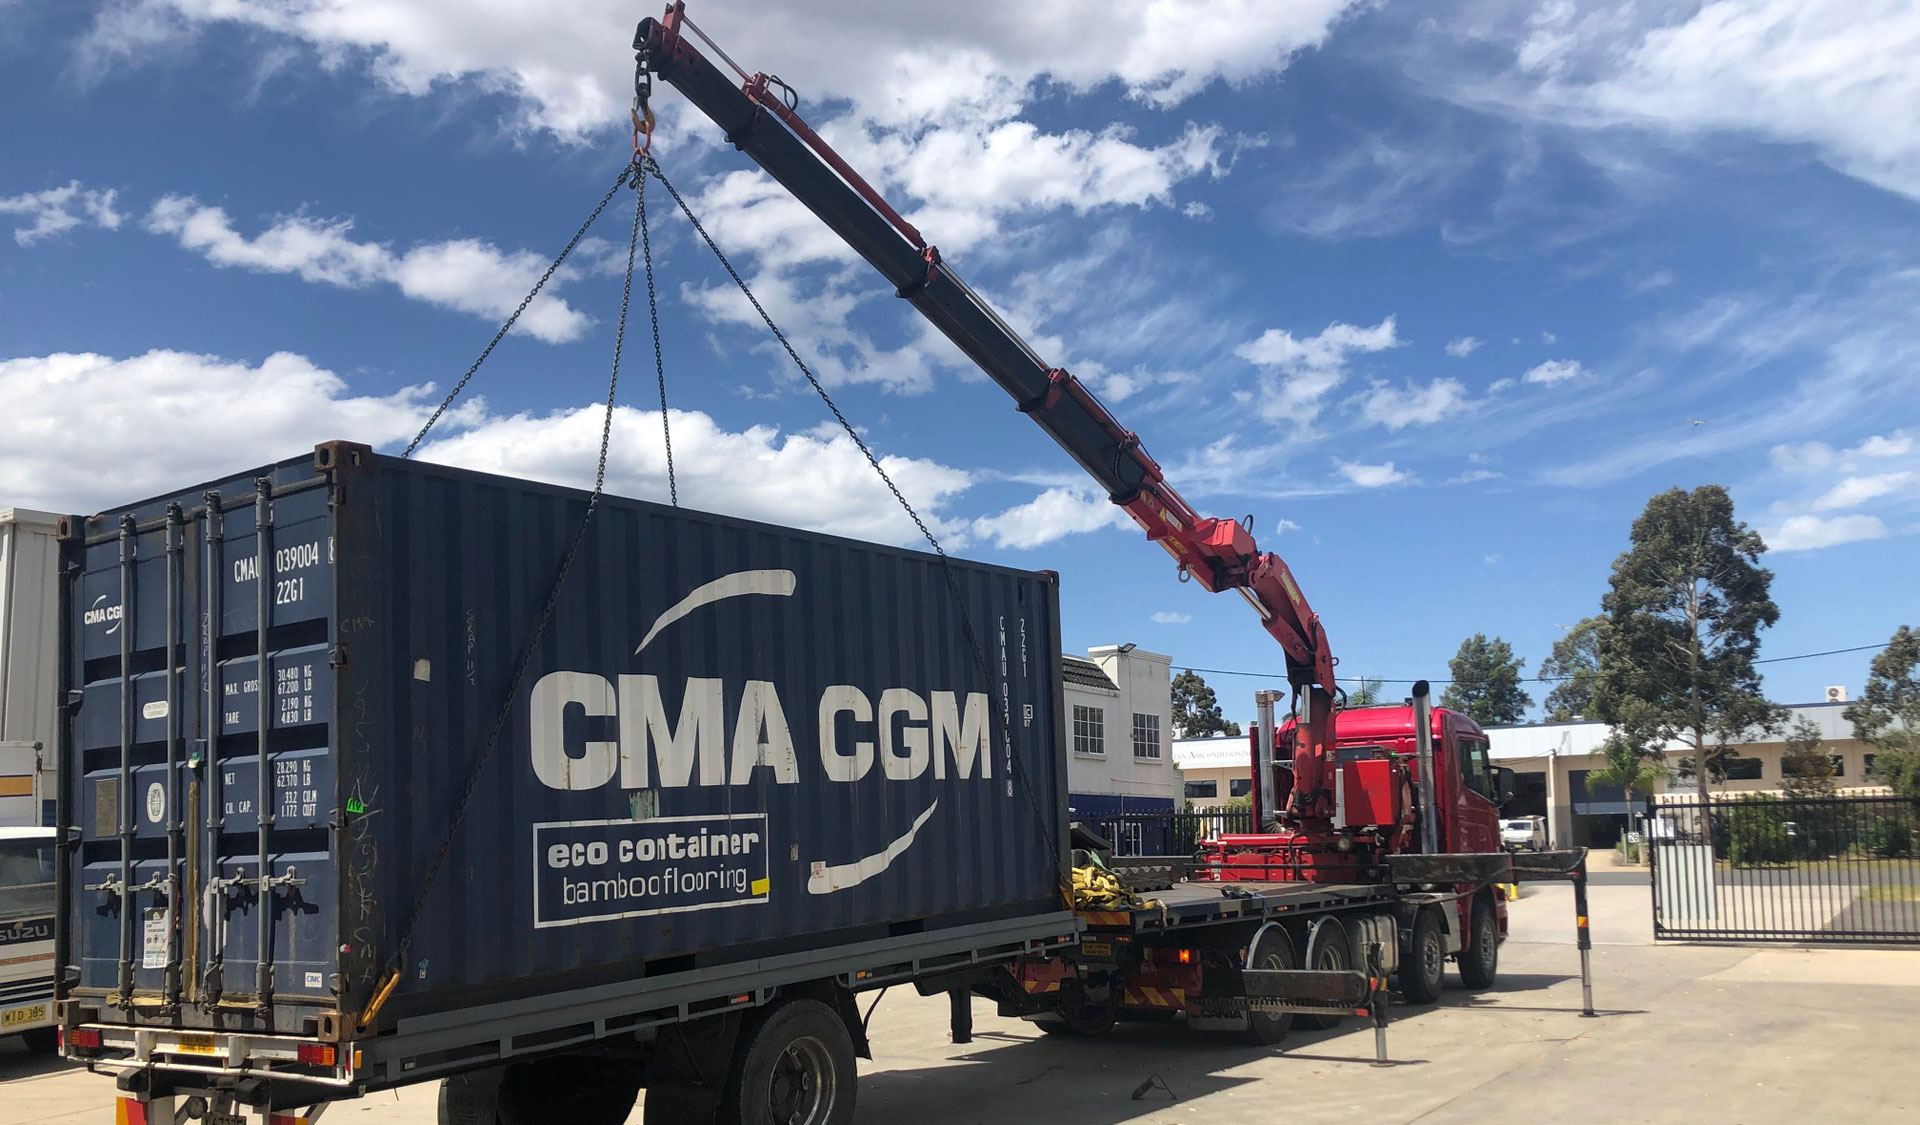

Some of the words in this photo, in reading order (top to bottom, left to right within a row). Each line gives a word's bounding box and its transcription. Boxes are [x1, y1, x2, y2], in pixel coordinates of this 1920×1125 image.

[276, 541, 319, 573] 039004
[276, 577, 304, 605] 22G1
[84, 608, 106, 625] CMA
[107, 605, 123, 620] CG
[243, 679, 259, 693] GROS
[303, 665, 312, 677] KG
[304, 678, 312, 691] LB
[304, 695, 312, 707] KG
[225, 712, 239, 724] TARE
[303, 708, 312, 721] LB
[530, 670, 800, 791] CMA
[818, 684, 992, 782] CGM
[1188, 750, 1250, 760] AIRCONDITIONIN
[303, 760, 311, 772] KG
[225, 772, 235, 785] NET
[303, 773, 311, 786] LB
[239, 800, 253, 813] CAP.
[1629, 833, 1639, 842] 26
[547, 840, 608, 869] eco
[618, 827, 759, 863] container
